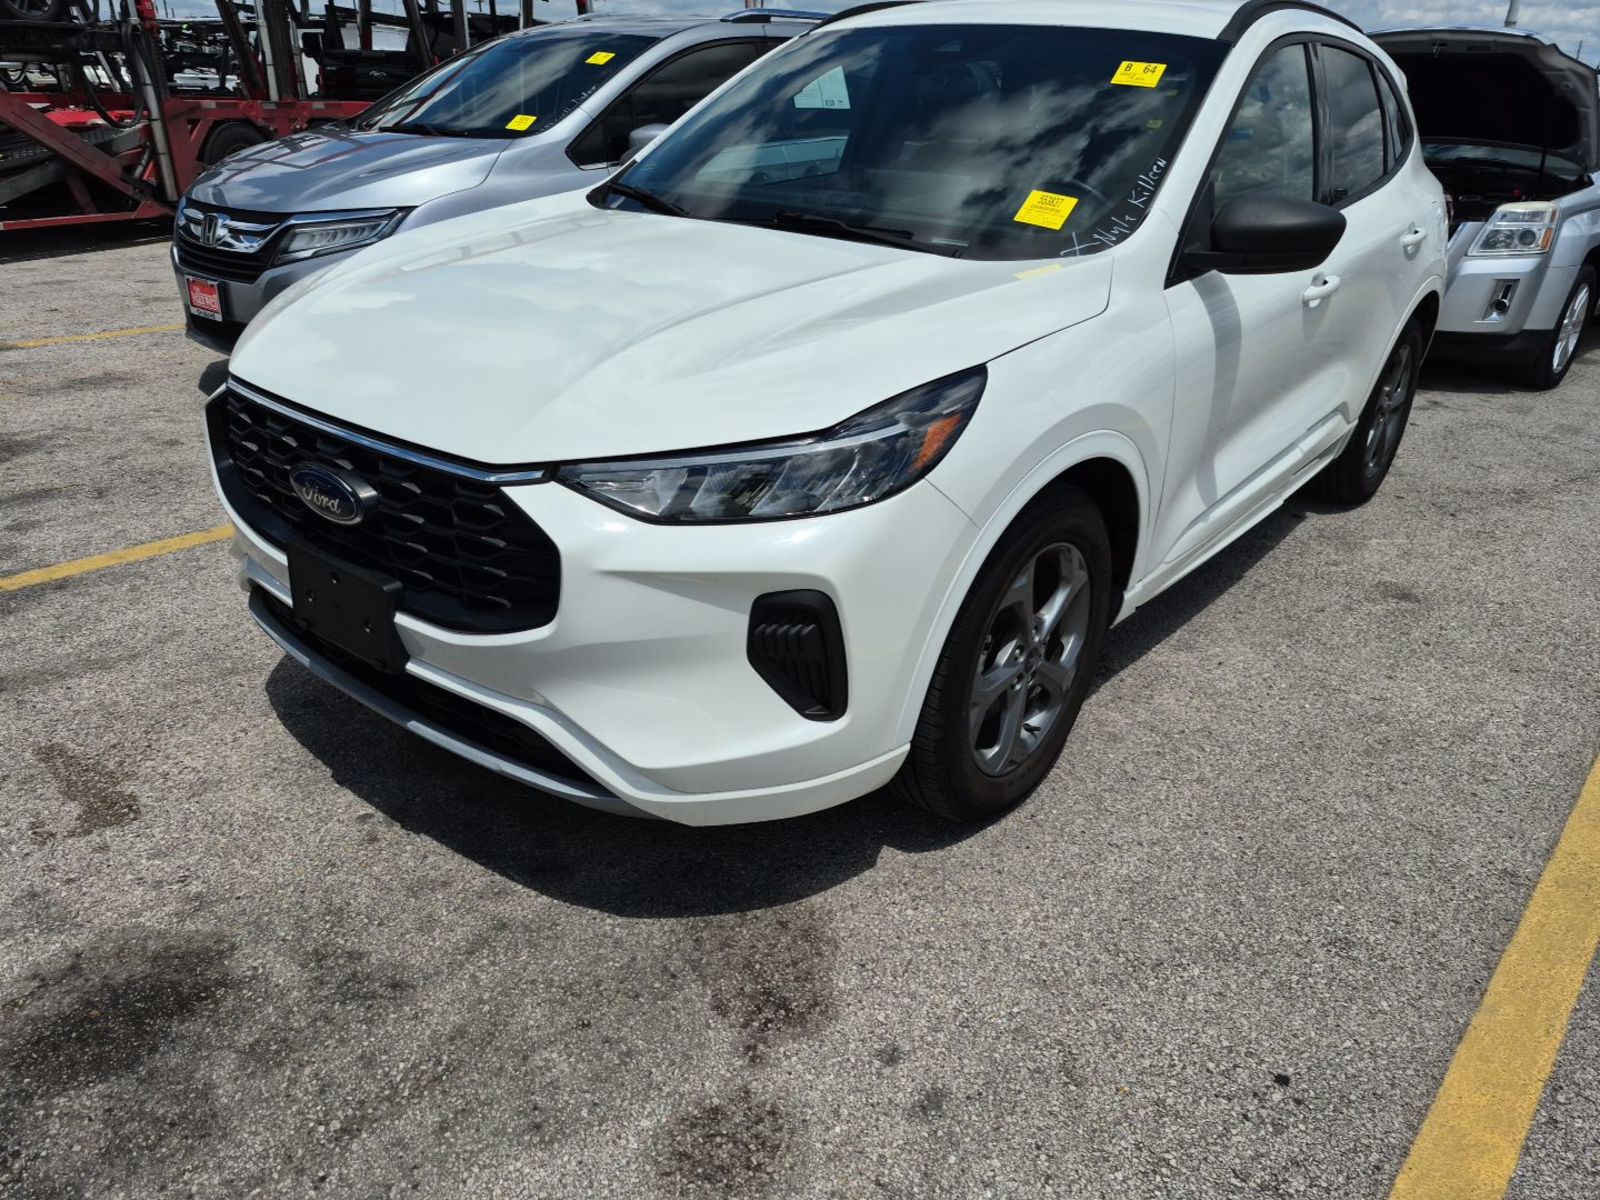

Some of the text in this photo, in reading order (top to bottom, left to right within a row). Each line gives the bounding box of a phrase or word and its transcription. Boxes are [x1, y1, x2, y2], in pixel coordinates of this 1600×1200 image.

[1124, 63, 1158, 74] B 64
[301, 481, 341, 514] Ford
